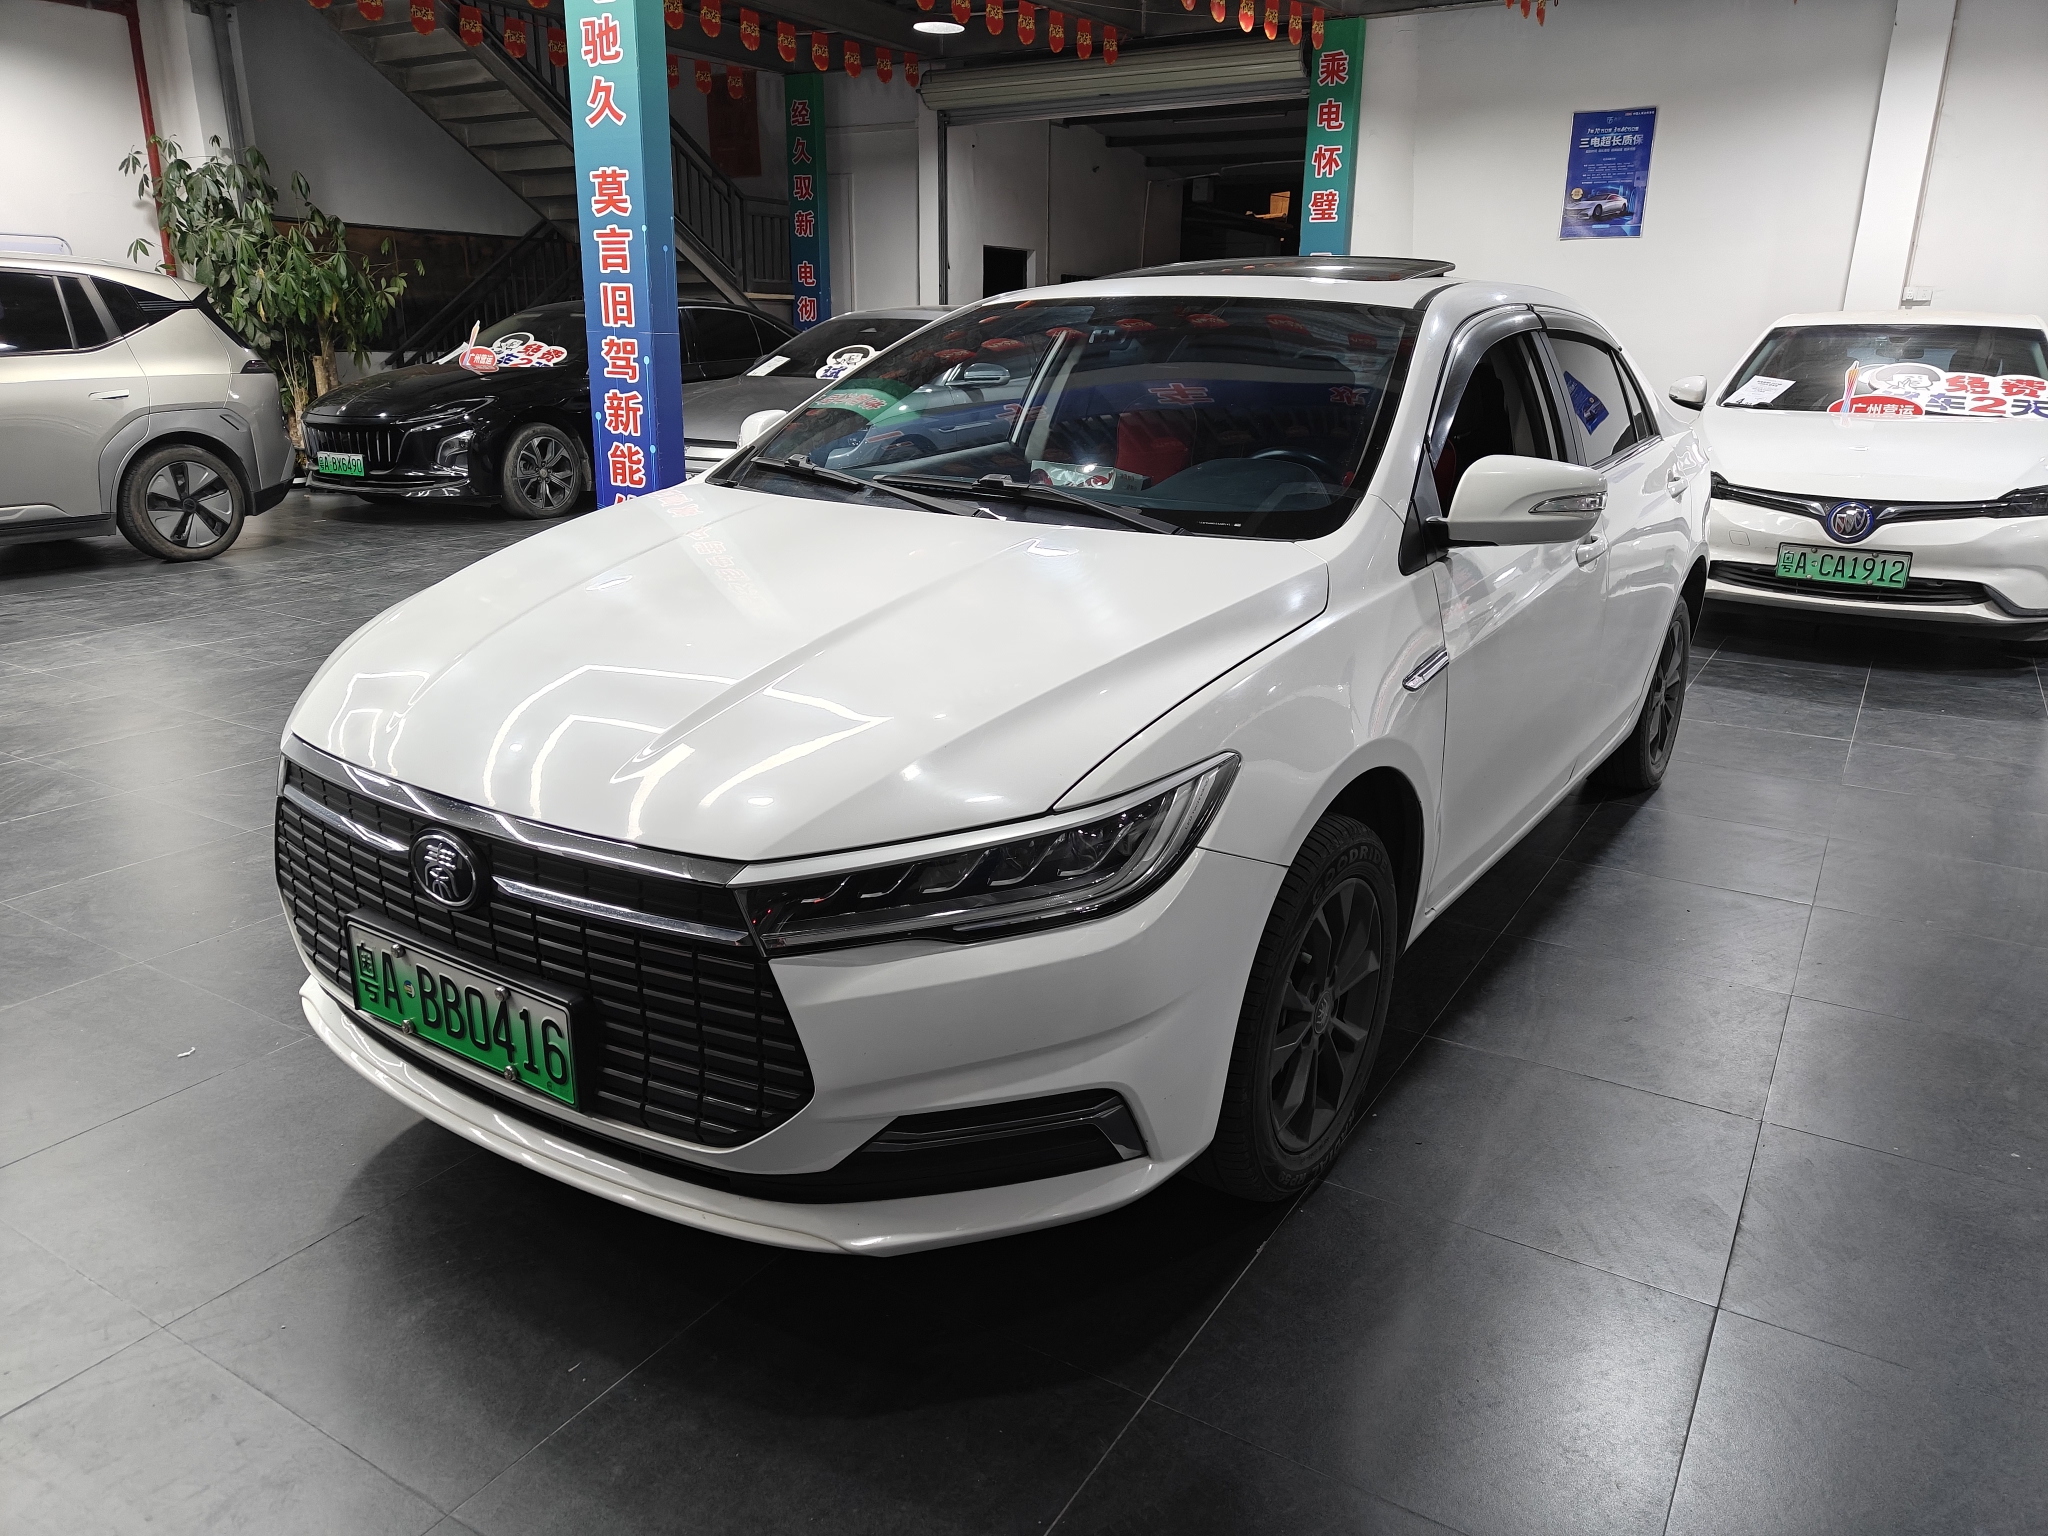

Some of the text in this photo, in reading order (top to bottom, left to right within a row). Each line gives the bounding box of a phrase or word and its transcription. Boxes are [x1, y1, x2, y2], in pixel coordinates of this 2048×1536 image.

[1309, 49, 1349, 222] 乘电怀璧
[1579, 134, 1644, 148] 三电超长质保
[791, 99, 818, 322] 经久驭新 电彻
[580, 0, 646, 505] 驰久 莫言旧驾新能
[1851, 403, 1915, 415] 广州营运
[1945, 374, 2047, 398] 免费
[1312, 845, 1388, 905] GOODRIDE
